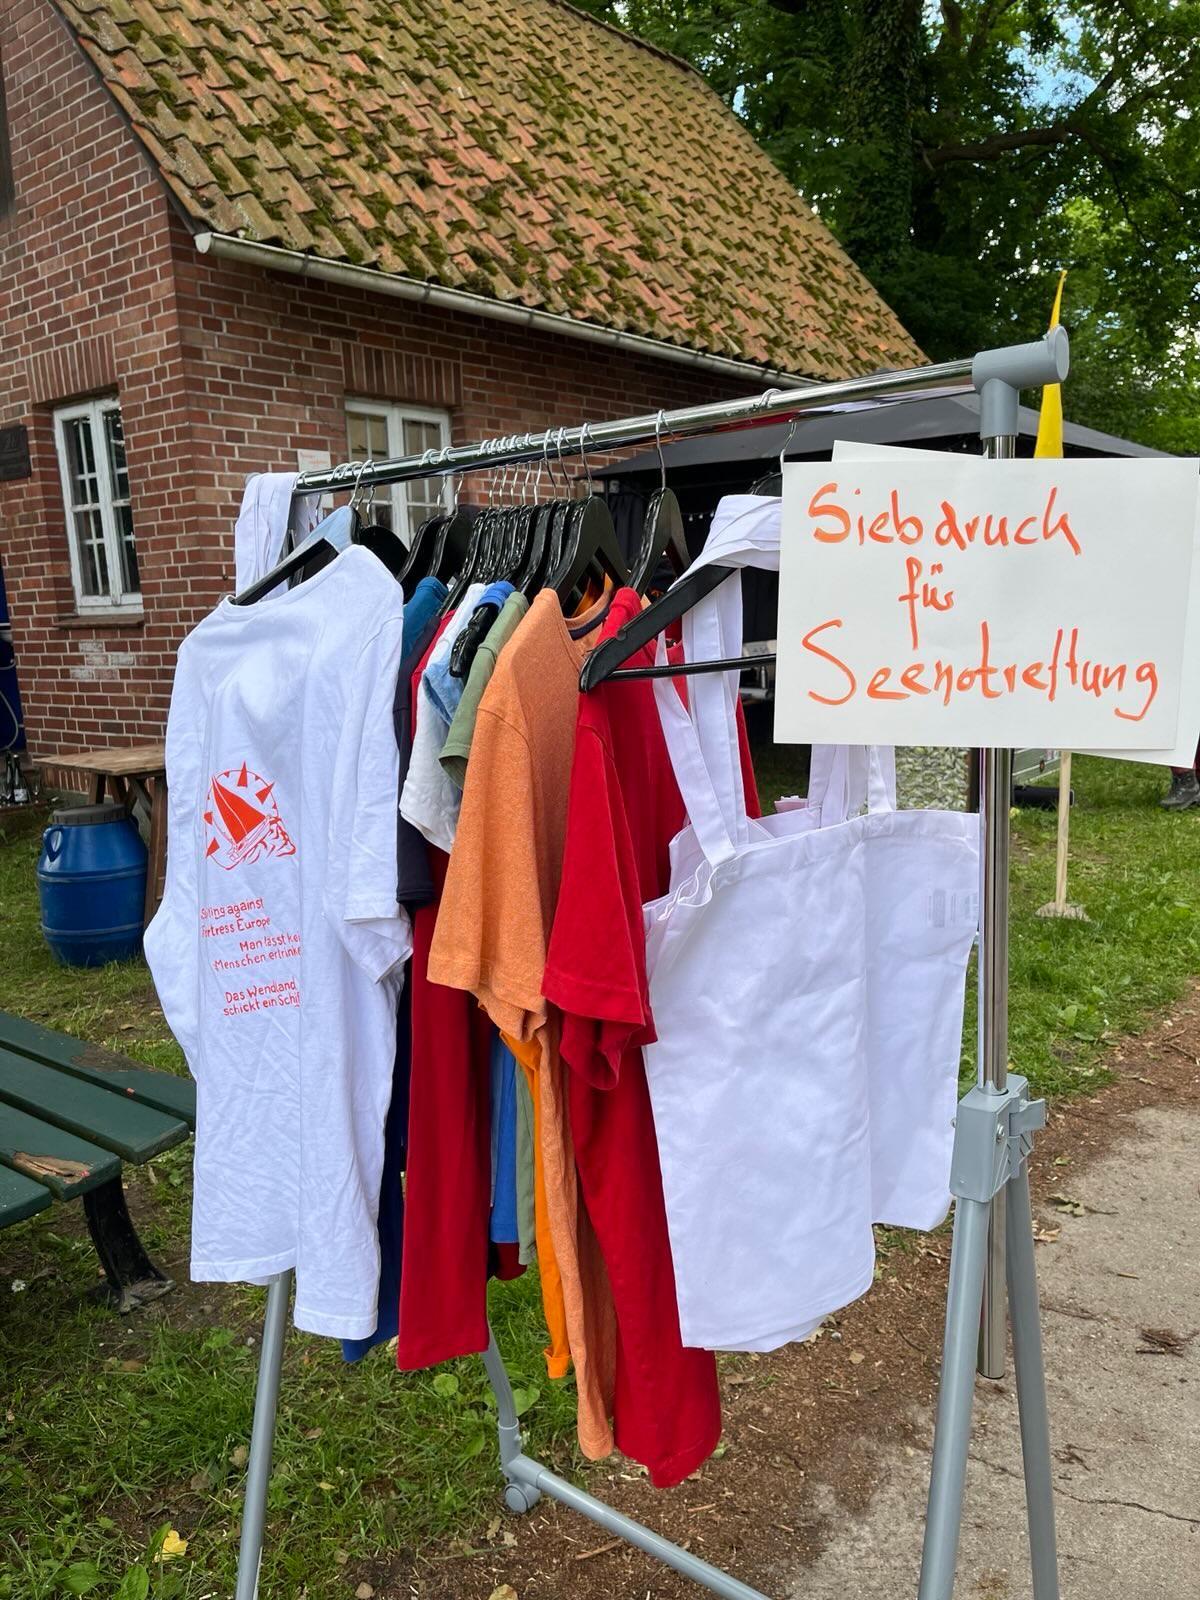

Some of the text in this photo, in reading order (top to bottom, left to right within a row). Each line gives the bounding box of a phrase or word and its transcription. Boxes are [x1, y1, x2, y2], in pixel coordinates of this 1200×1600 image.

[898, 556, 954, 650] für
[801, 618, 1159, 721] Seenotrettung
[227, 898, 263, 917] against
[240, 940, 262, 951] Man
[214, 954, 265, 970] Menschen
[225, 977, 296, 1003] Das Wendland
[224, 999, 260, 1015] schickt
[263, 999, 277, 1007] ein
